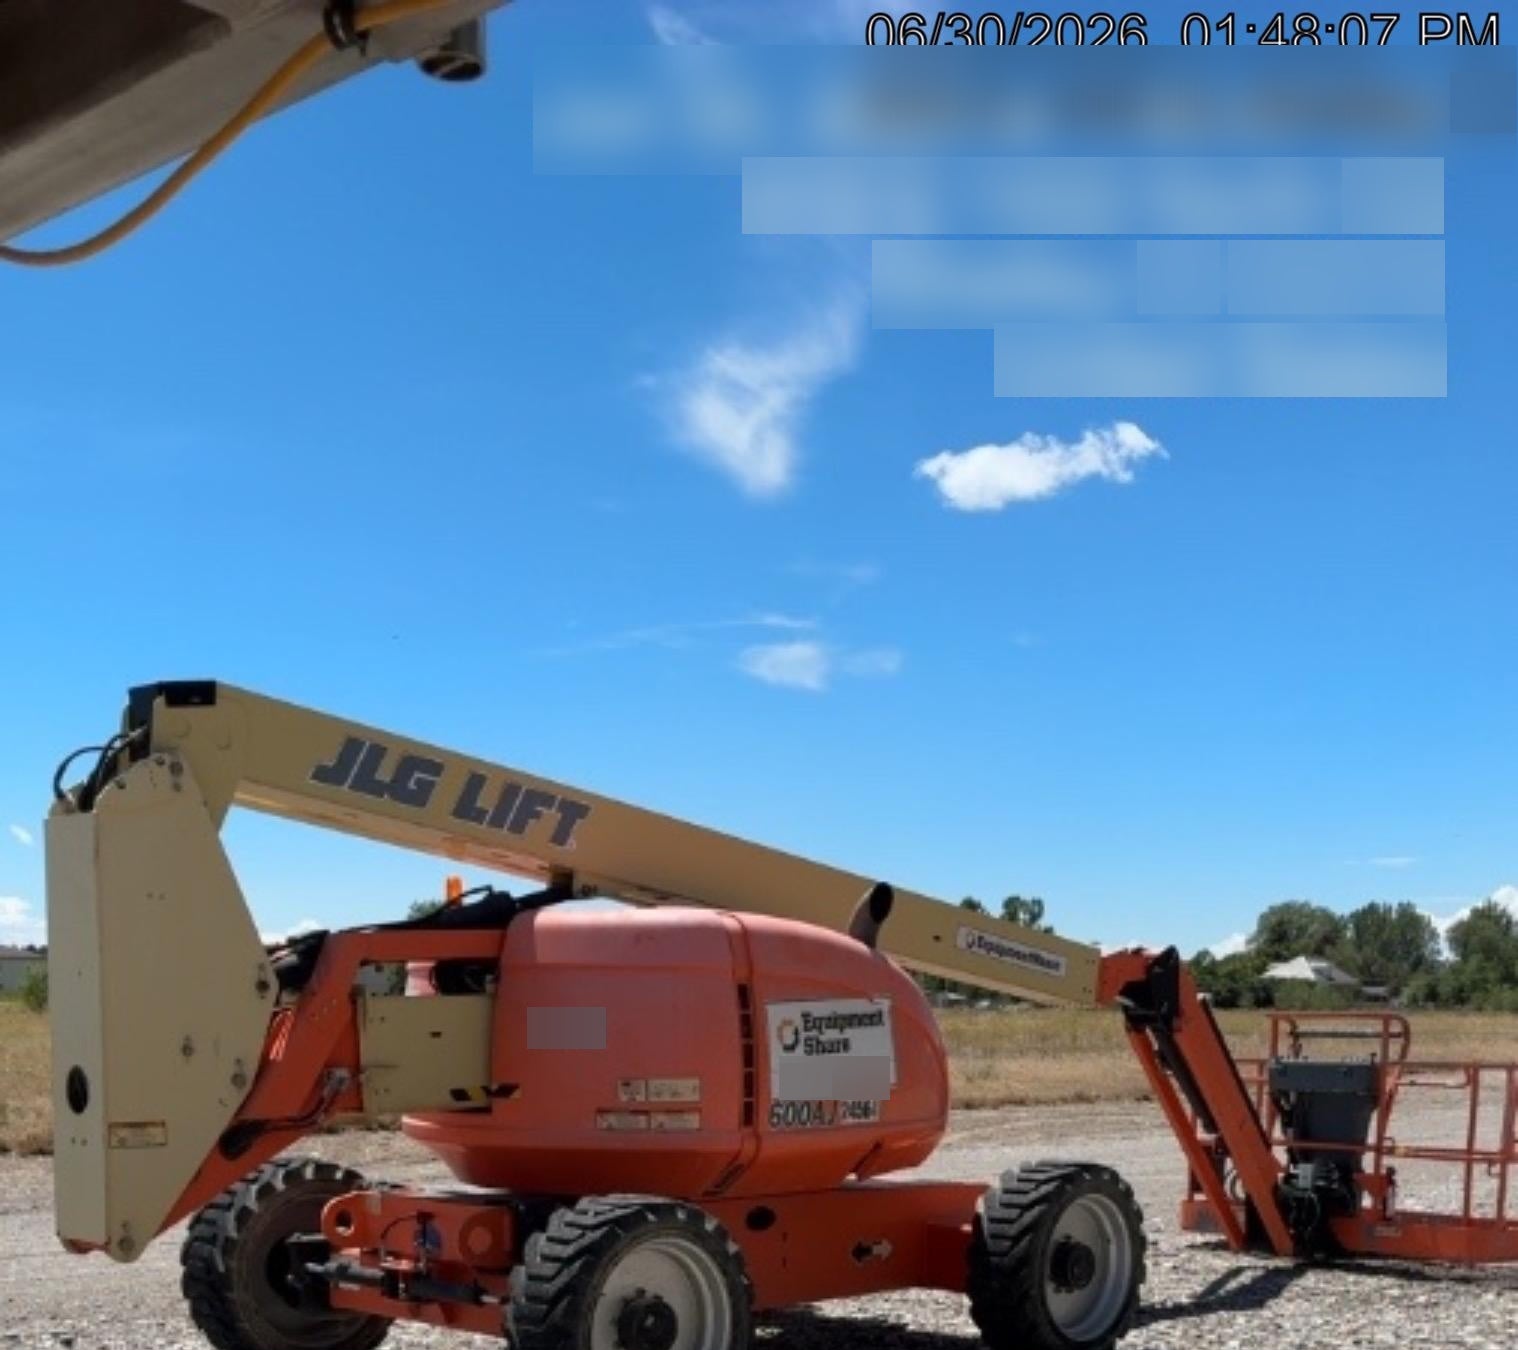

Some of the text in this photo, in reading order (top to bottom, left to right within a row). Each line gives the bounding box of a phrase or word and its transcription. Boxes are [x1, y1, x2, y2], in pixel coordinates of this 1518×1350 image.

[310, 737, 591, 848] JLG LIFT
[801, 1010, 885, 1035] Equipment
[803, 1036, 851, 1056] Share
